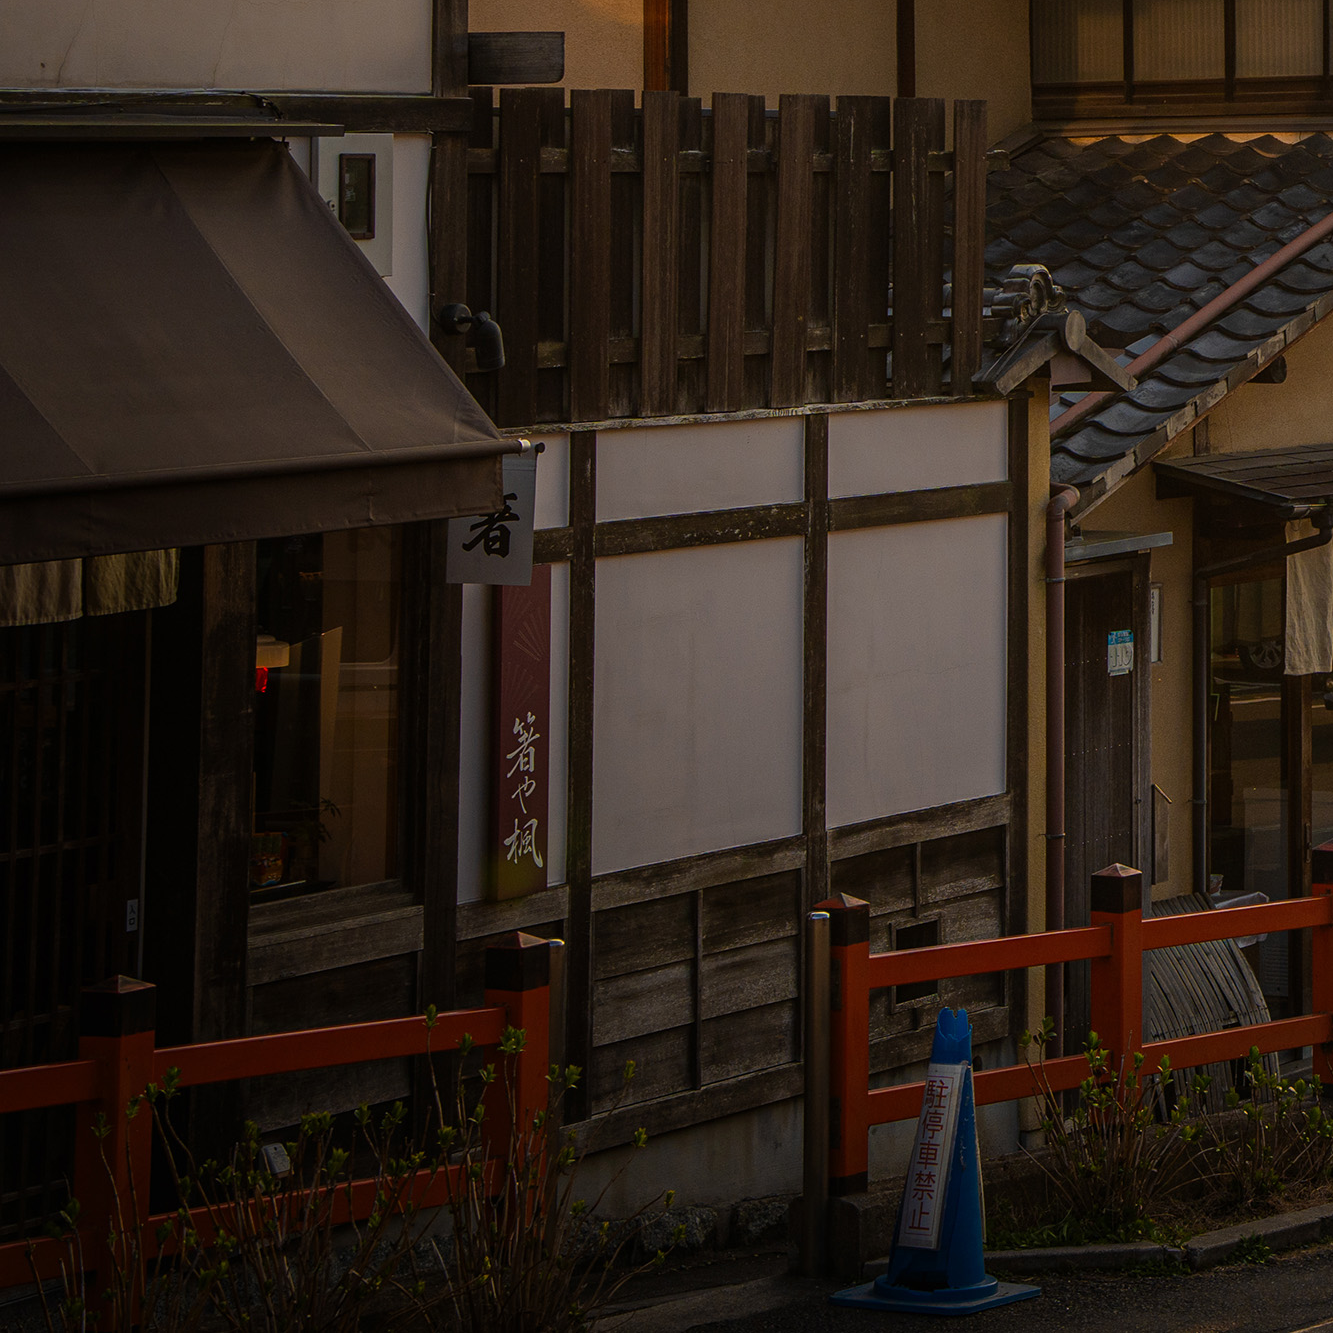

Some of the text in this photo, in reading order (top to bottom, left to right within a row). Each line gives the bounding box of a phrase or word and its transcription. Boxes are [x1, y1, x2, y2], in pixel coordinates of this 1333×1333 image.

[128, 904, 137, 926] 入口
[908, 1078, 949, 1233] 駐停車禁止
